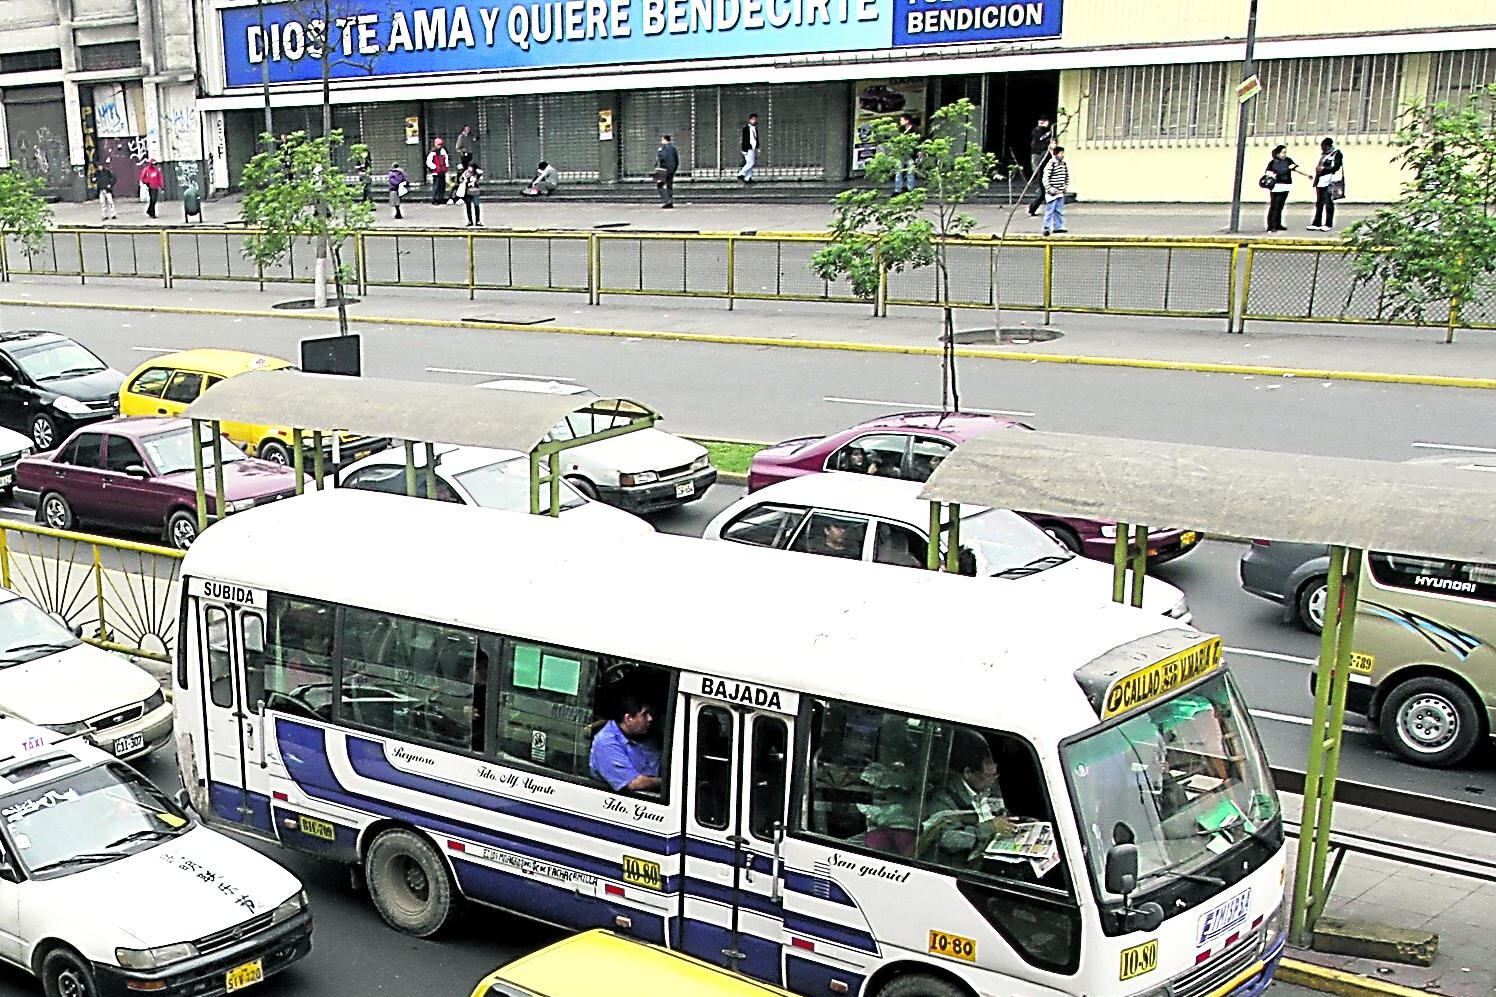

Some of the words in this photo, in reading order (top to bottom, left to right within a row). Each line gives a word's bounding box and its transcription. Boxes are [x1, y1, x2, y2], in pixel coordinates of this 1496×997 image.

[906, 2, 1044, 35] BENDICION
[247, 18, 326, 64] DIOS
[335, 13, 379, 56] TE
[387, 6, 476, 53] AMA
[481, 7, 500, 46] Y
[507, 0, 633, 52] QUIERE
[203, 580, 255, 605] SUBIDA
[1415, 574, 1476, 593] HYUNDAI
[700, 677, 783, 711] BAJADA
[1124, 669, 1160, 707] CALLAO
[22, 737, 44, 751] TAXI
[391, 745, 436, 766] Reynoso
[826, 852, 857, 871] San
[929, 931, 974, 957] 10-80
[1122, 943, 1157, 977] 10-80
